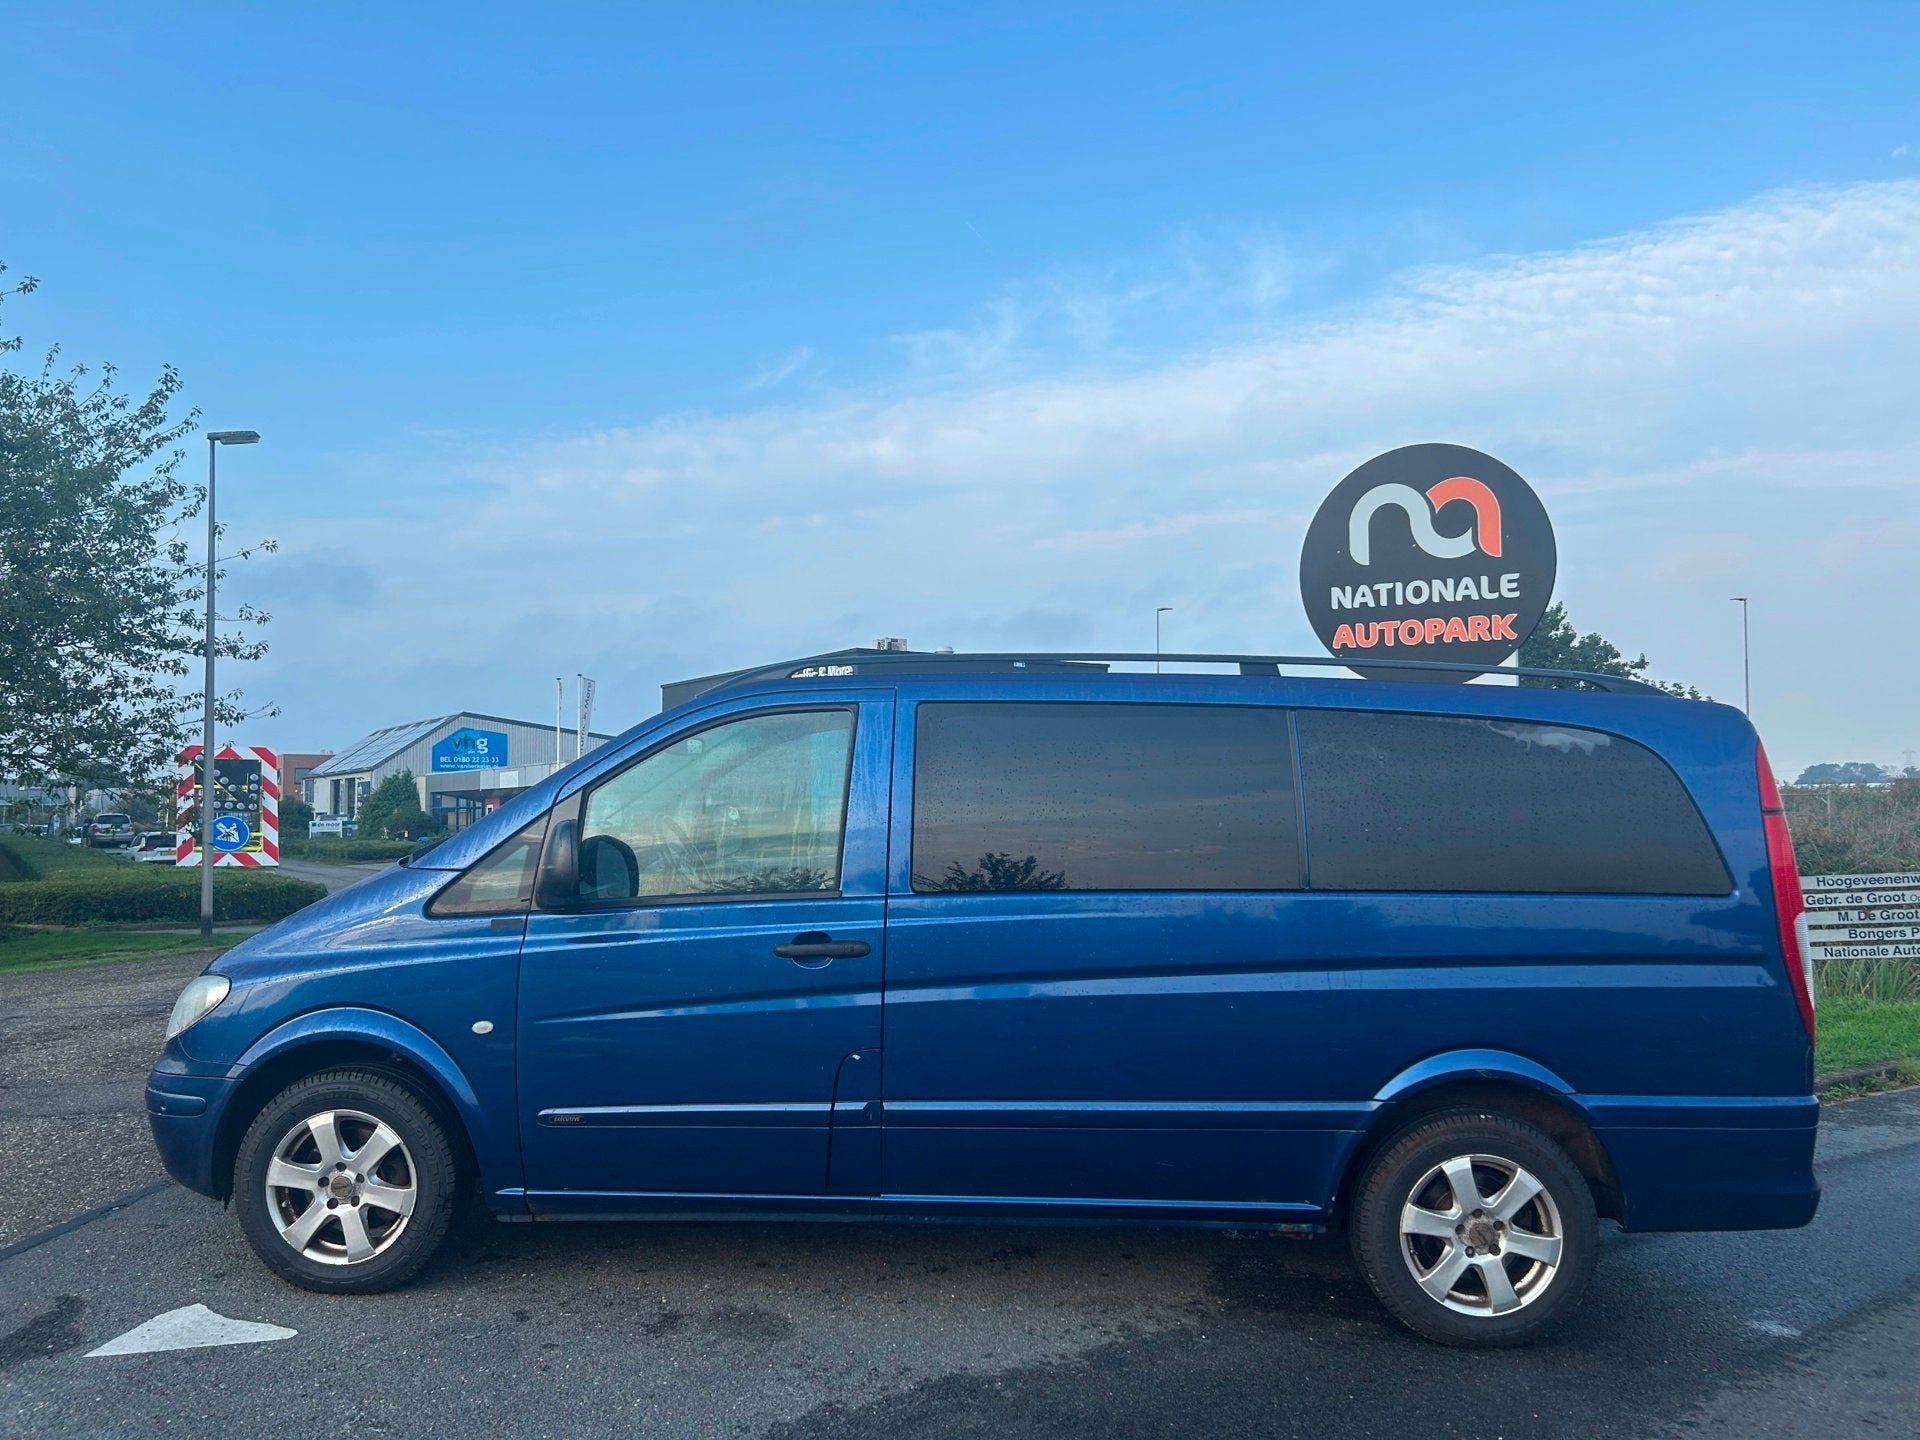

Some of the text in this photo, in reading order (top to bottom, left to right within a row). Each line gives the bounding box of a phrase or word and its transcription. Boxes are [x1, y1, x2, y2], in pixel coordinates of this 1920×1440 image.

[1330, 572, 1520, 610] NATIONALE
[1332, 613, 1519, 649] AUTOPARK
[827, 665, 854, 677] More
[452, 734, 489, 754] vhg
[1805, 894, 1842, 905] Gebr.
[1846, 893, 1863, 904] de
[1866, 892, 1906, 903] Groot
[1837, 910, 1919, 922] M. De Groot
[1848, 928, 1907, 940] Bongers
[1823, 946, 1889, 958] Nationale
